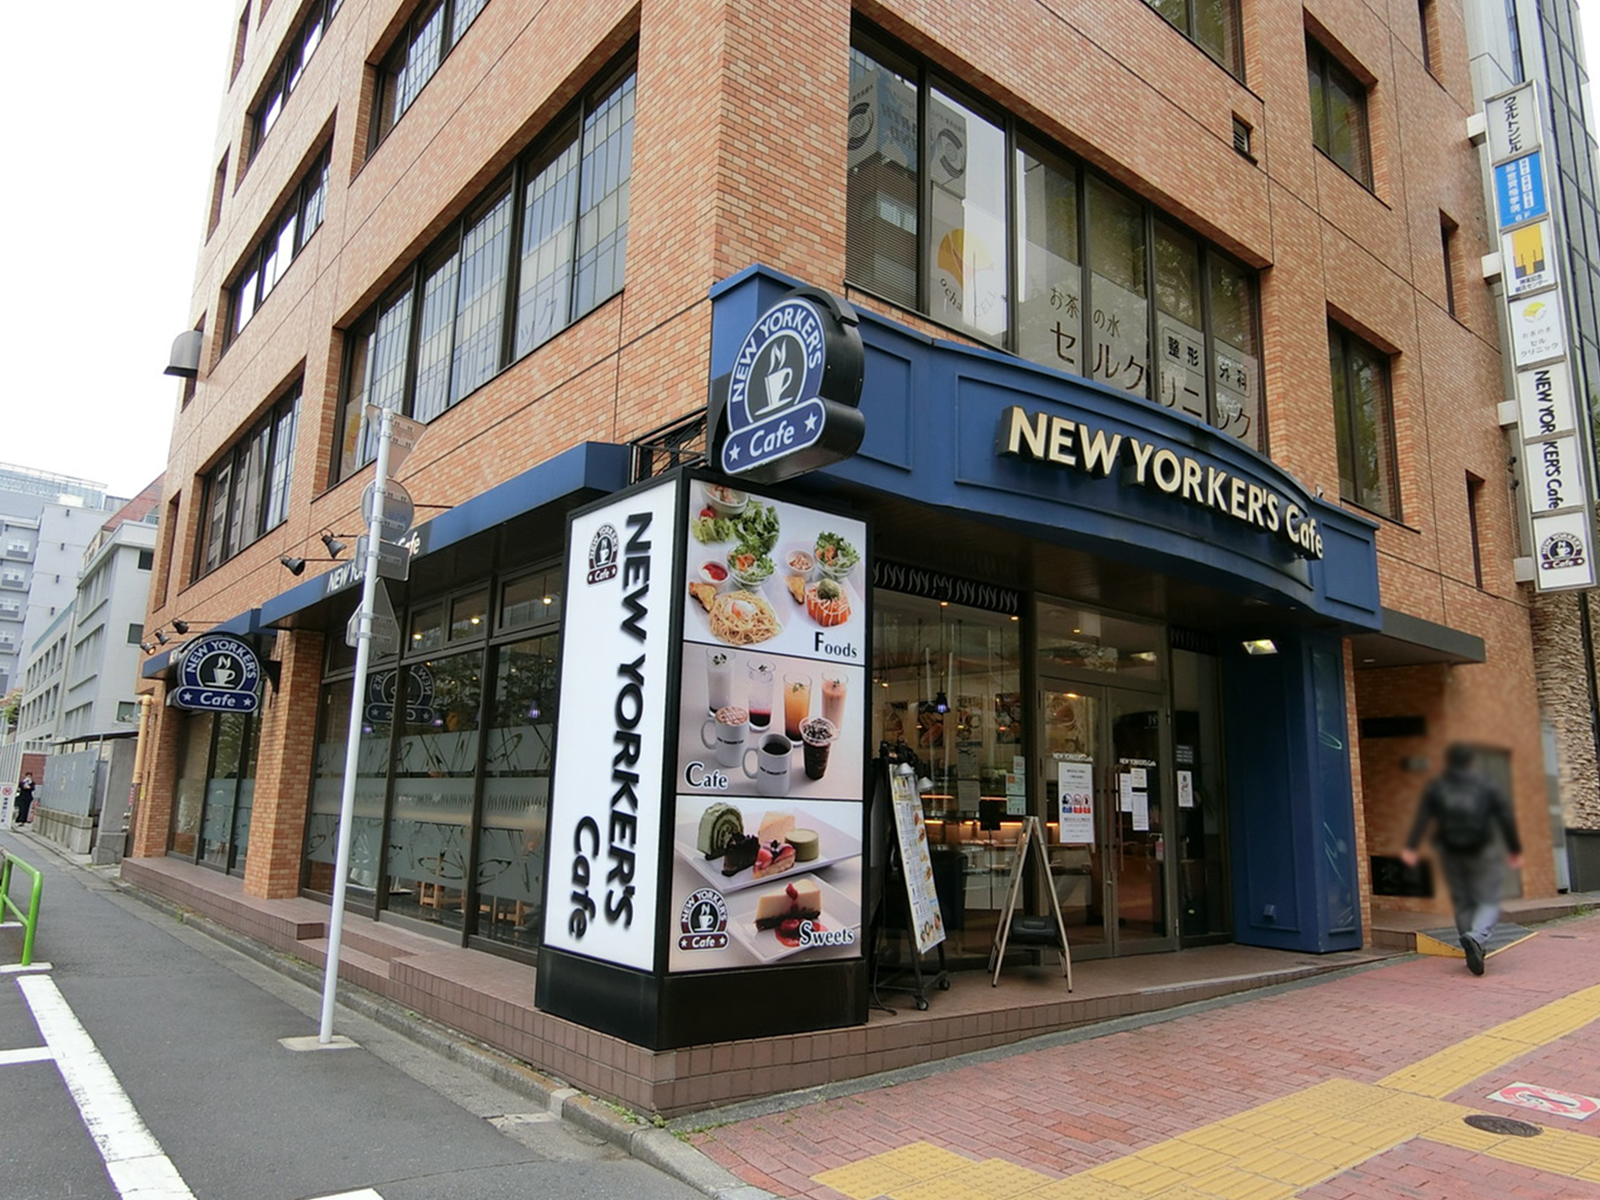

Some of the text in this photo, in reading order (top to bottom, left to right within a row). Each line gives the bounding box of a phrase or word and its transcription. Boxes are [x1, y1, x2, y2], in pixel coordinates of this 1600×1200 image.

[940, 278, 962, 312] ocha
[731, 307, 823, 403] NEW YORKER'S
[749, 420, 795, 457] Cafe
[1534, 369, 1553, 402] NEW
[1547, 479, 1564, 509] Cafe
[1008, 405, 1324, 560] NEW YORKER'S Cafe
[327, 566, 350, 594] NEW
[594, 568, 610, 581] Cafe
[1552, 560, 1574, 569] Cafe
[186, 645, 209, 673] NEW
[211, 640, 257, 679] YORKER'S
[814, 631, 857, 658] Foods
[199, 692, 236, 707] Cafe
[603, 512, 653, 931] NEW YORKER'S
[684, 761, 729, 789] Cafe
[568, 815, 600, 941] Cafe
[681, 889, 728, 923] NEW YORKER'S
[691, 935, 716, 950] Cafe
[798, 919, 855, 948] Sweets
